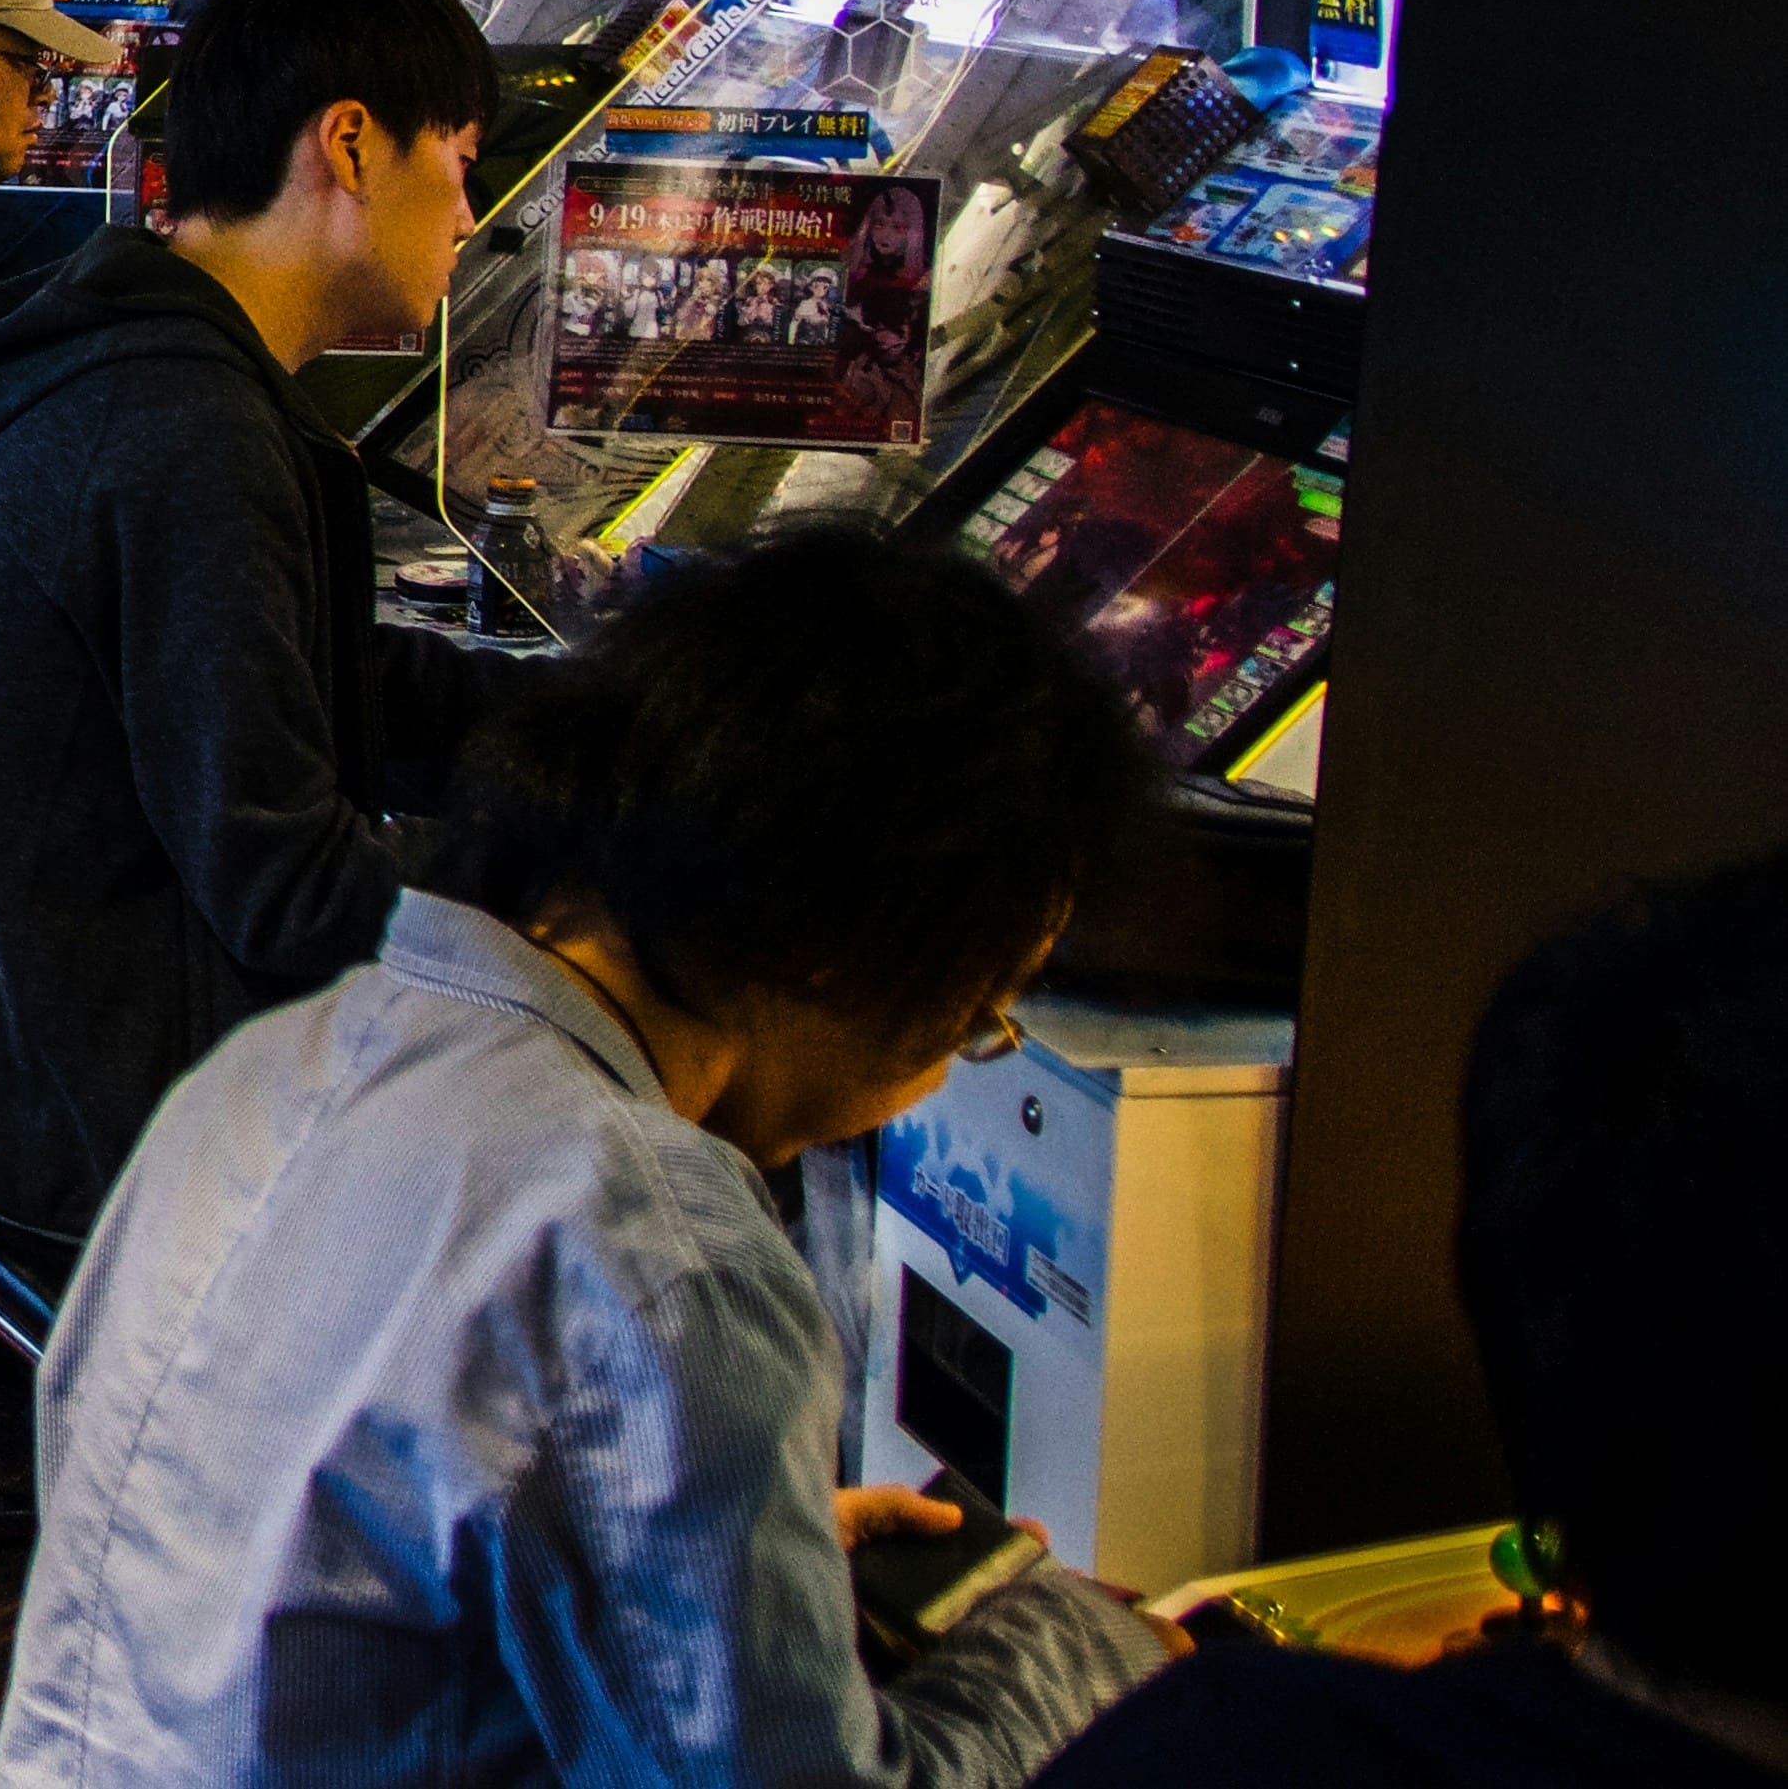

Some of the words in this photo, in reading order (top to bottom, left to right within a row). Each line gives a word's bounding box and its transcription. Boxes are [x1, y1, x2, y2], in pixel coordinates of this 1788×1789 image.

[689, 4, 743, 61] Girls
[717, 111, 865, 137] 初回プレイ無料!
